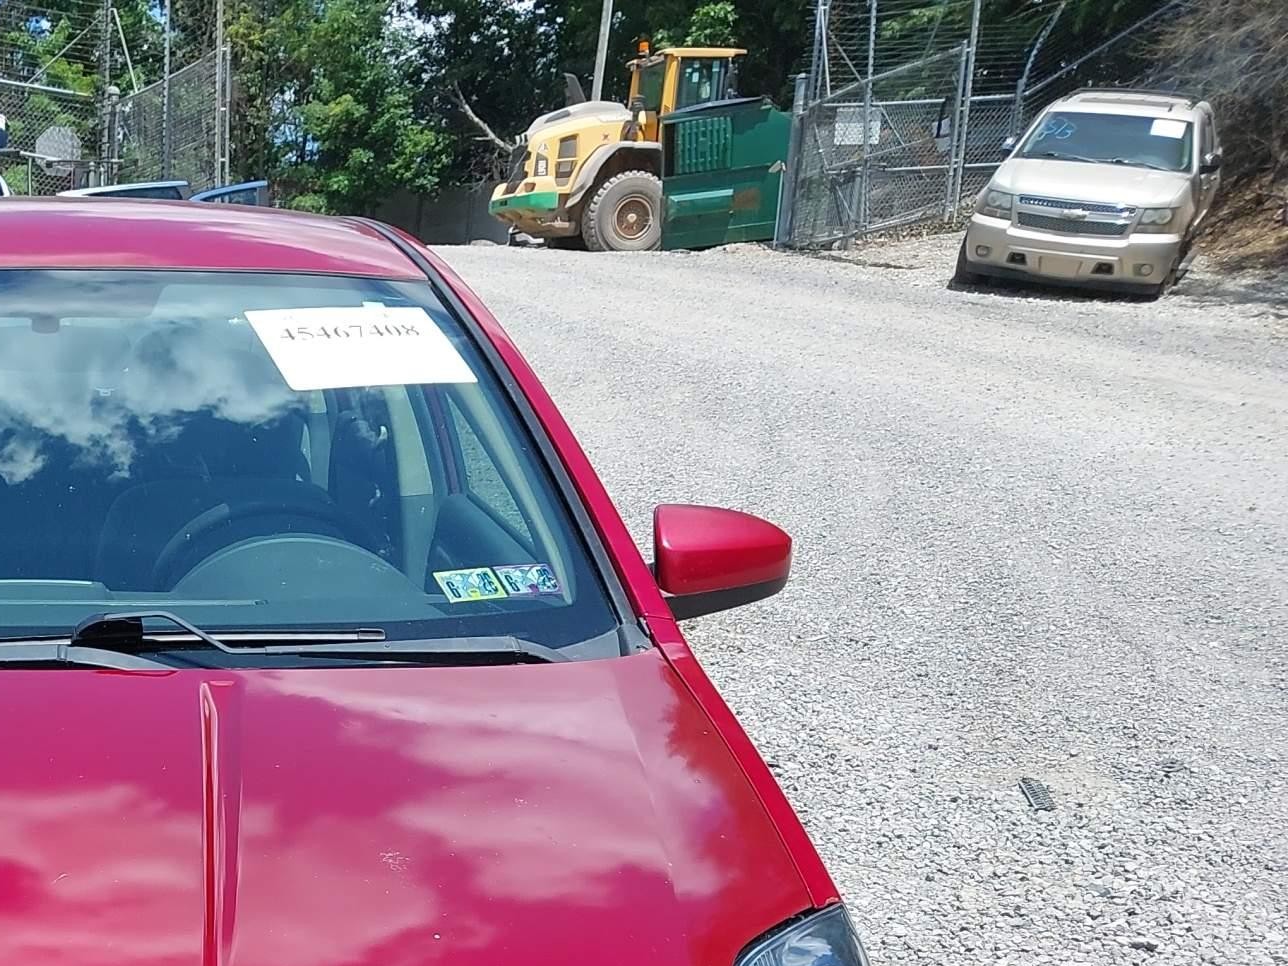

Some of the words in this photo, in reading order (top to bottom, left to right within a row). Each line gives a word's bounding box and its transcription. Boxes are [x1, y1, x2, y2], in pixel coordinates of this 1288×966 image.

[280, 324, 420, 341] 45467408
[445, 580, 462, 598] 6
[504, 574, 521, 592] 6
